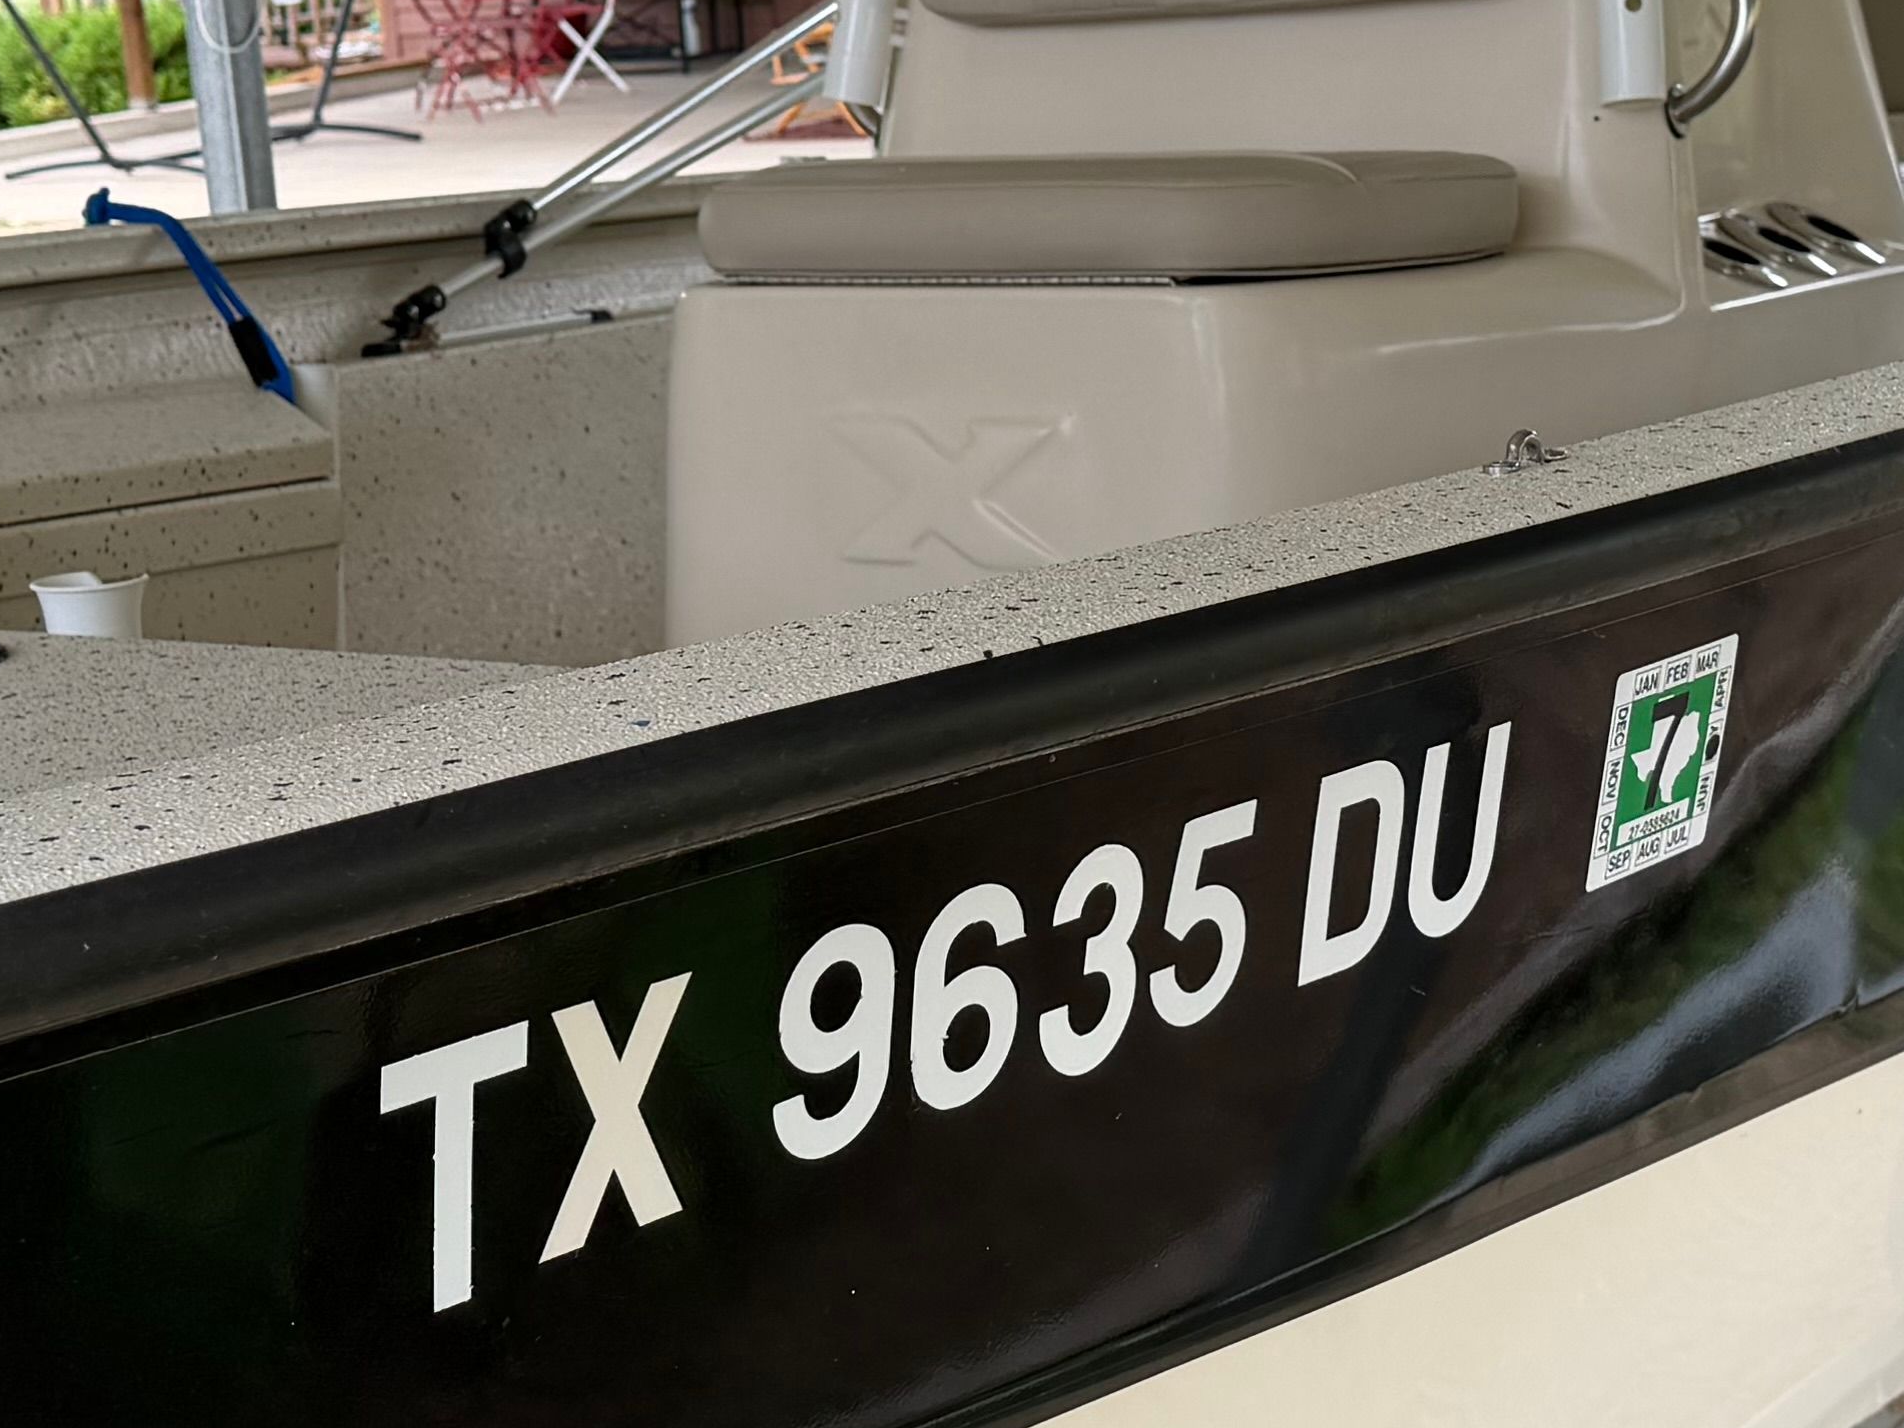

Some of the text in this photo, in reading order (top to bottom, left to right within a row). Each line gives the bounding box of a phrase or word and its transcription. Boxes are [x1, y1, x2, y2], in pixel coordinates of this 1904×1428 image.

[1634, 650, 1719, 696] JAN FEB MAR
[1613, 706, 1629, 748] DEC
[1605, 761, 1621, 799] NOV
[1696, 776, 1710, 812] JUN
[1597, 815, 1612, 852] OCT
[1607, 825, 1688, 872] SEP AUG JUL
[380, 721, 1512, 1314] TX 9635 DU
